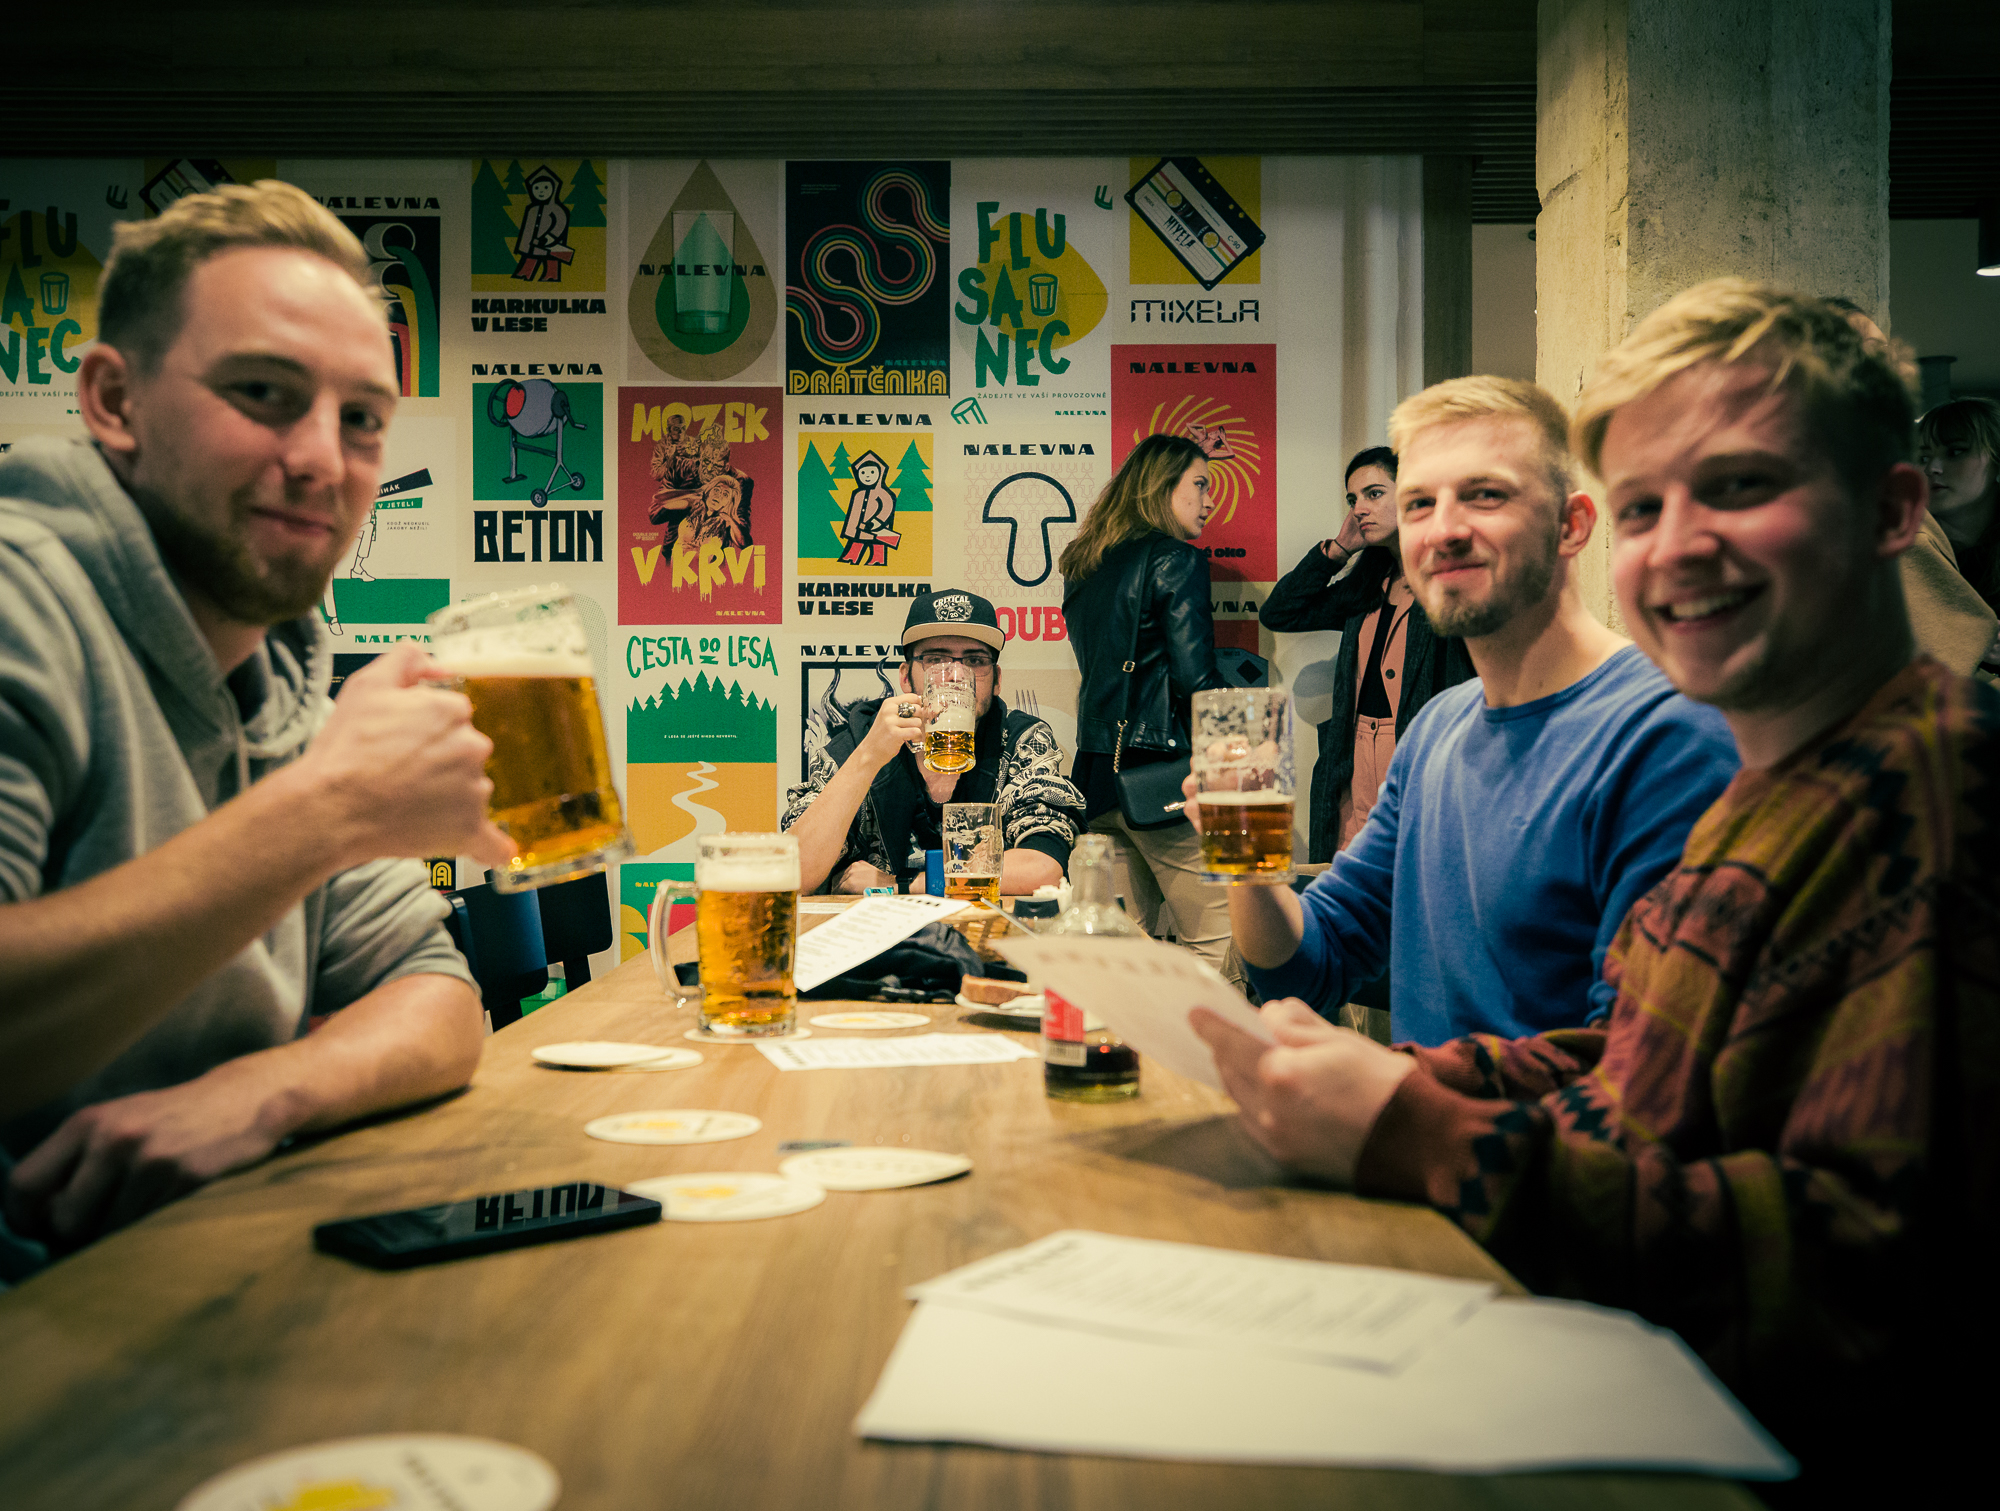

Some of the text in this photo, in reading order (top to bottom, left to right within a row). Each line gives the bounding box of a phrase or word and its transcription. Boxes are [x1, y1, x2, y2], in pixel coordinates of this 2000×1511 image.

[976, 201, 1066, 271] FLU
[471, 299, 606, 314] KARKULKA
[1131, 300, 1260, 324] MIXELA
[471, 317, 548, 332] V LESE
[975, 320, 1071, 388] NEC
[631, 402, 770, 443] MOZEK
[387, 500, 414, 508] JETELI
[473, 510, 603, 562] BETON
[631, 545, 662, 586] V
[798, 583, 932, 598] KARKULKA
[932, 594, 970, 608] CRITICAL
[798, 601, 873, 616] V LESE
[995, 606, 1070, 641] OUB
[626, 636, 693, 678] CESTA
[728, 635, 779, 677] LESA
